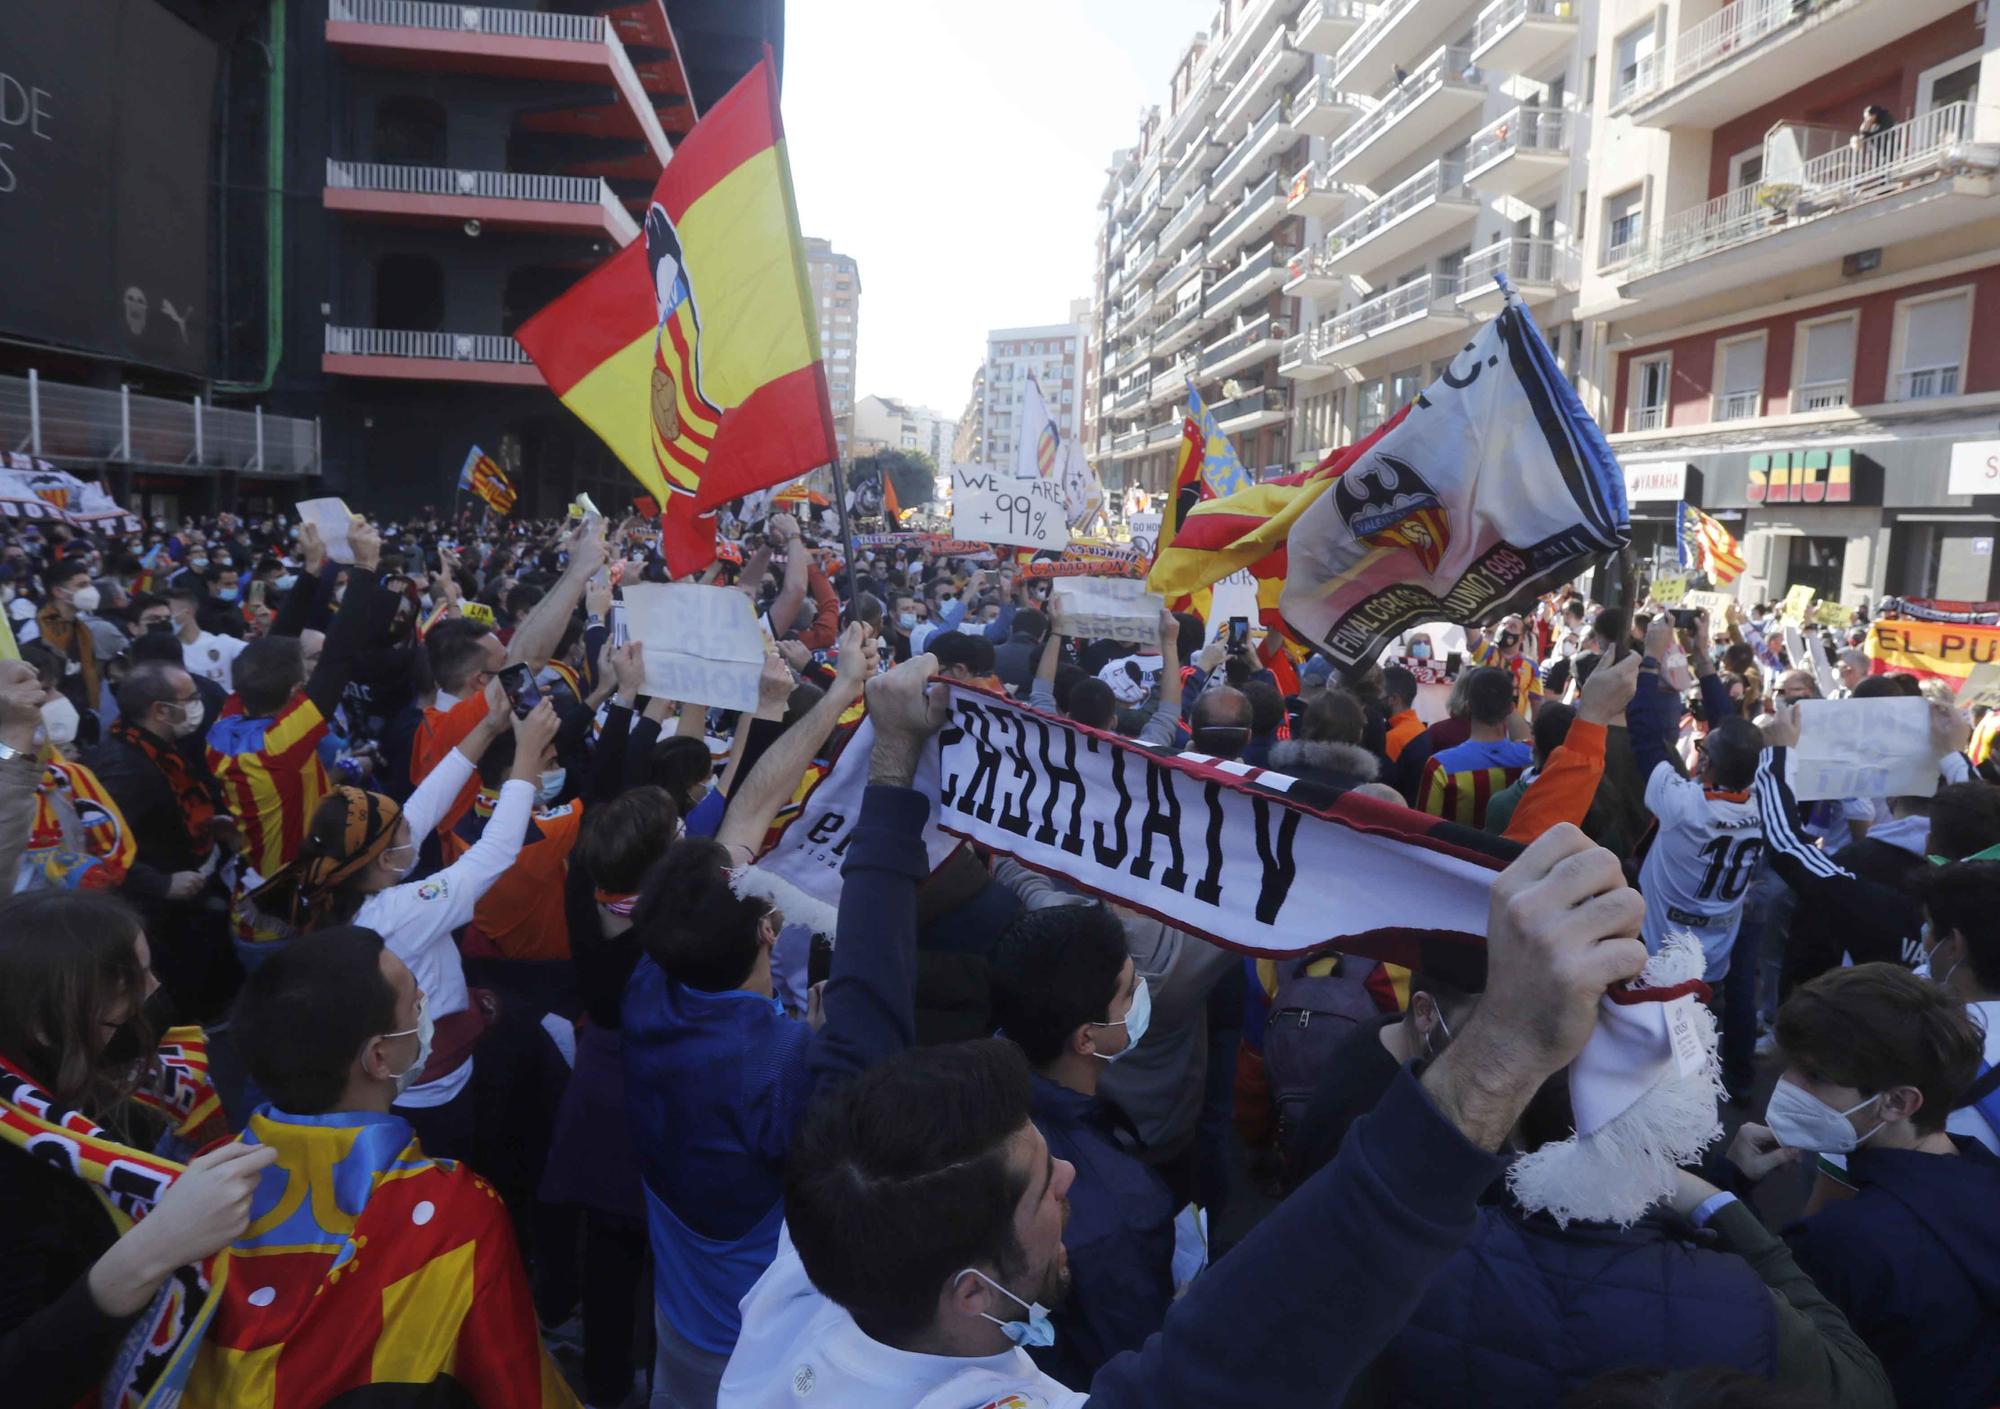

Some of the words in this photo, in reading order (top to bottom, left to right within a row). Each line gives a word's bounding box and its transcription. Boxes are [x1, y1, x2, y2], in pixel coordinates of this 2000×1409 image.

[958, 469, 998, 492] WE
[1031, 481, 1062, 505] ARE
[1639, 473, 1679, 490] YAMAHA
[1746, 448, 1852, 503] SAICA
[1132, 522, 1145, 532] GO
[1444, 574, 1496, 616] JUNIO
[1480, 549, 1527, 586] 1999
[1332, 613, 1381, 654] FINAL
[1877, 627, 1925, 655] EL
[1939, 634, 1998, 663] PU
[1694, 835, 1763, 902] 10
